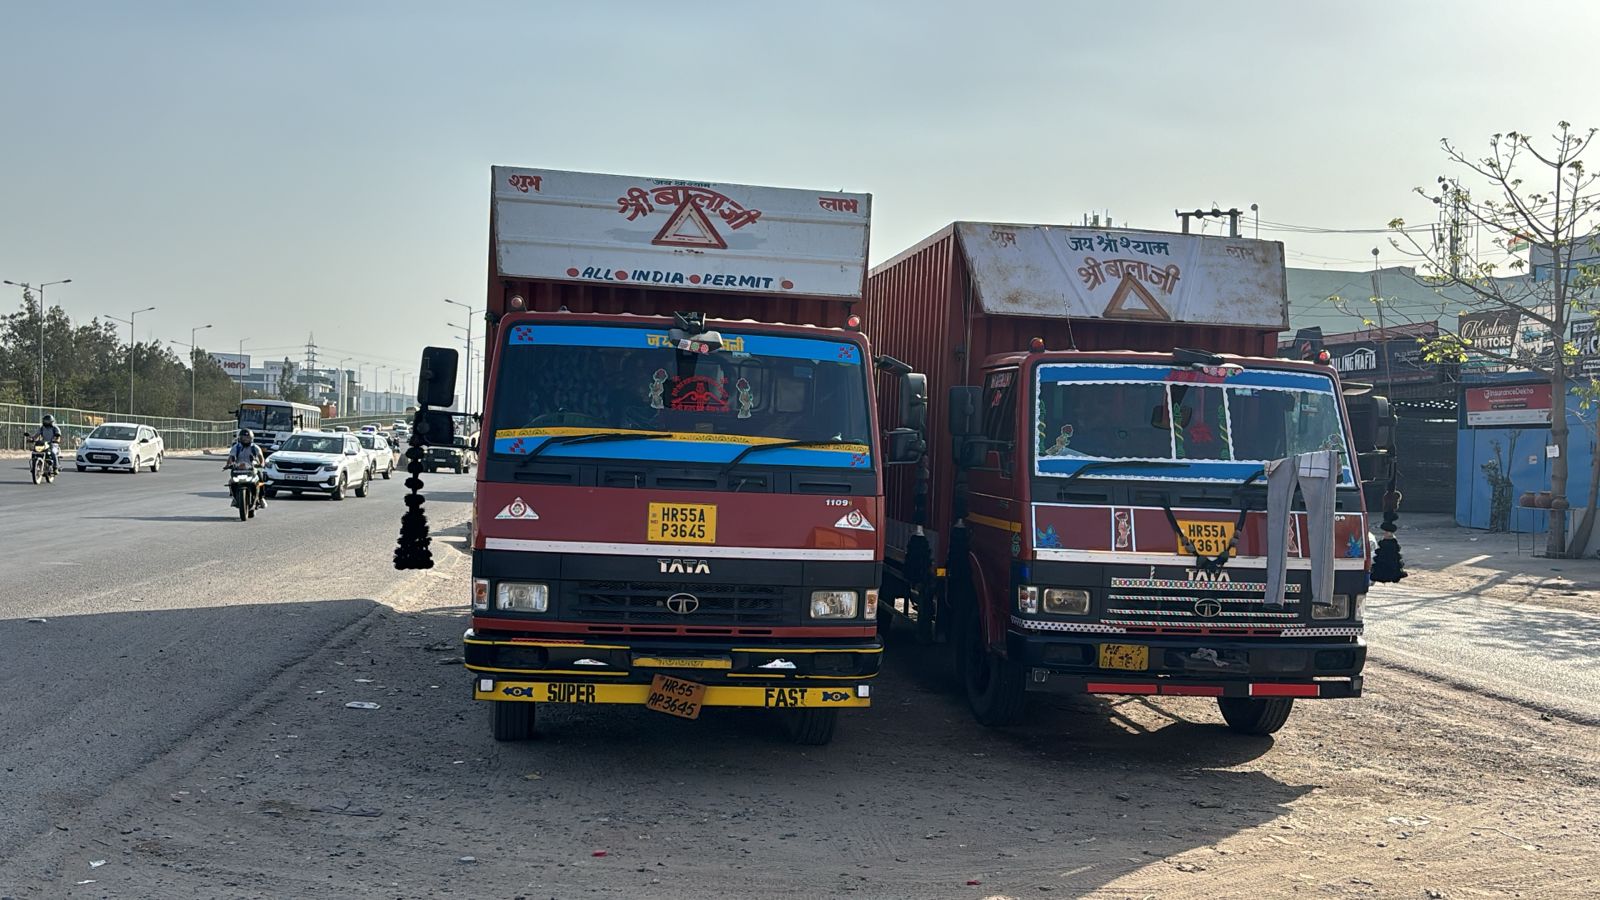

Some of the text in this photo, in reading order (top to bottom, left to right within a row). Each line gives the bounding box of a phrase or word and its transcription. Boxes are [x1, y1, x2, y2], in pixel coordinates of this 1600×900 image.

[508, 175, 543, 193] शुभ
[617, 186, 762, 230] श्री बालाजी
[819, 197, 859, 213] लाभ
[1067, 235, 1170, 256] जय श्री श्याम
[582, 266, 773, 289] ALL INDIA PERMIT
[1078, 257, 1180, 294] श्री बालाजी
[1461, 316, 1512, 338] Krishna
[1474, 335, 1512, 348] MOTORS
[223, 361, 246, 370] Hero
[1355, 353, 1377, 370] MAFIA
[662, 507, 705, 523] HR55A
[661, 523, 705, 538] P3645
[1188, 524, 1226, 538] HR55A
[657, 558, 711, 574] TATA
[547, 683, 808, 708] SUPER FAST
